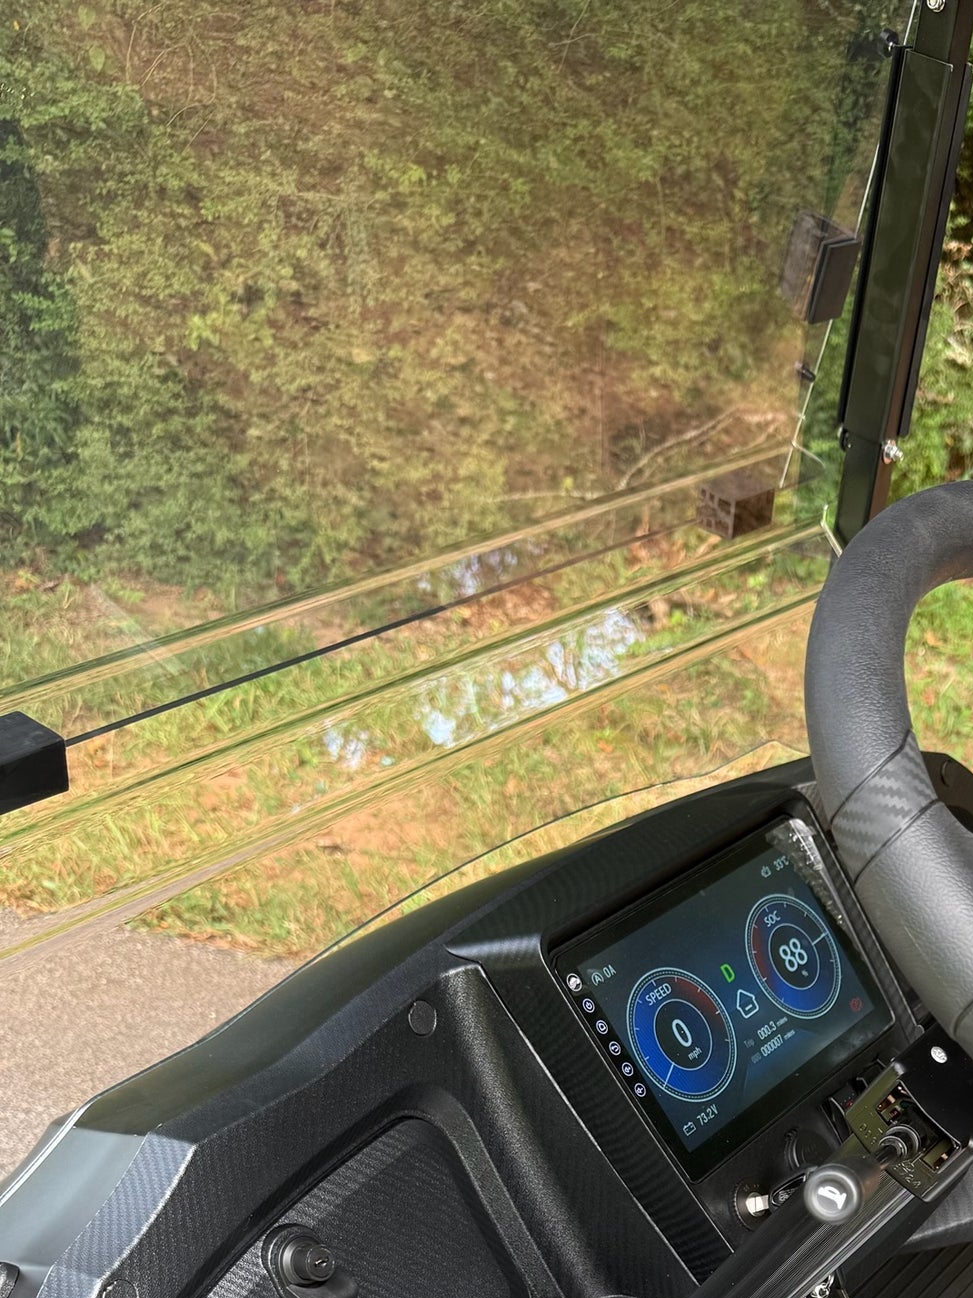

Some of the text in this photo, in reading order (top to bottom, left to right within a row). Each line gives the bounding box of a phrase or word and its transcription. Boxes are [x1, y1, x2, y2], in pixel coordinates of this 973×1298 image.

[764, 910, 781, 927] SOC
[779, 938, 808, 972] 88
[720, 964, 735, 983] D
[645, 983, 672, 1006] SPEED
[672, 1018, 692, 1047] 0
[757, 1020, 777, 1040] 000.3
[688, 1047, 703, 1062] mph
[696, 1104, 719, 1126] 73.2V
